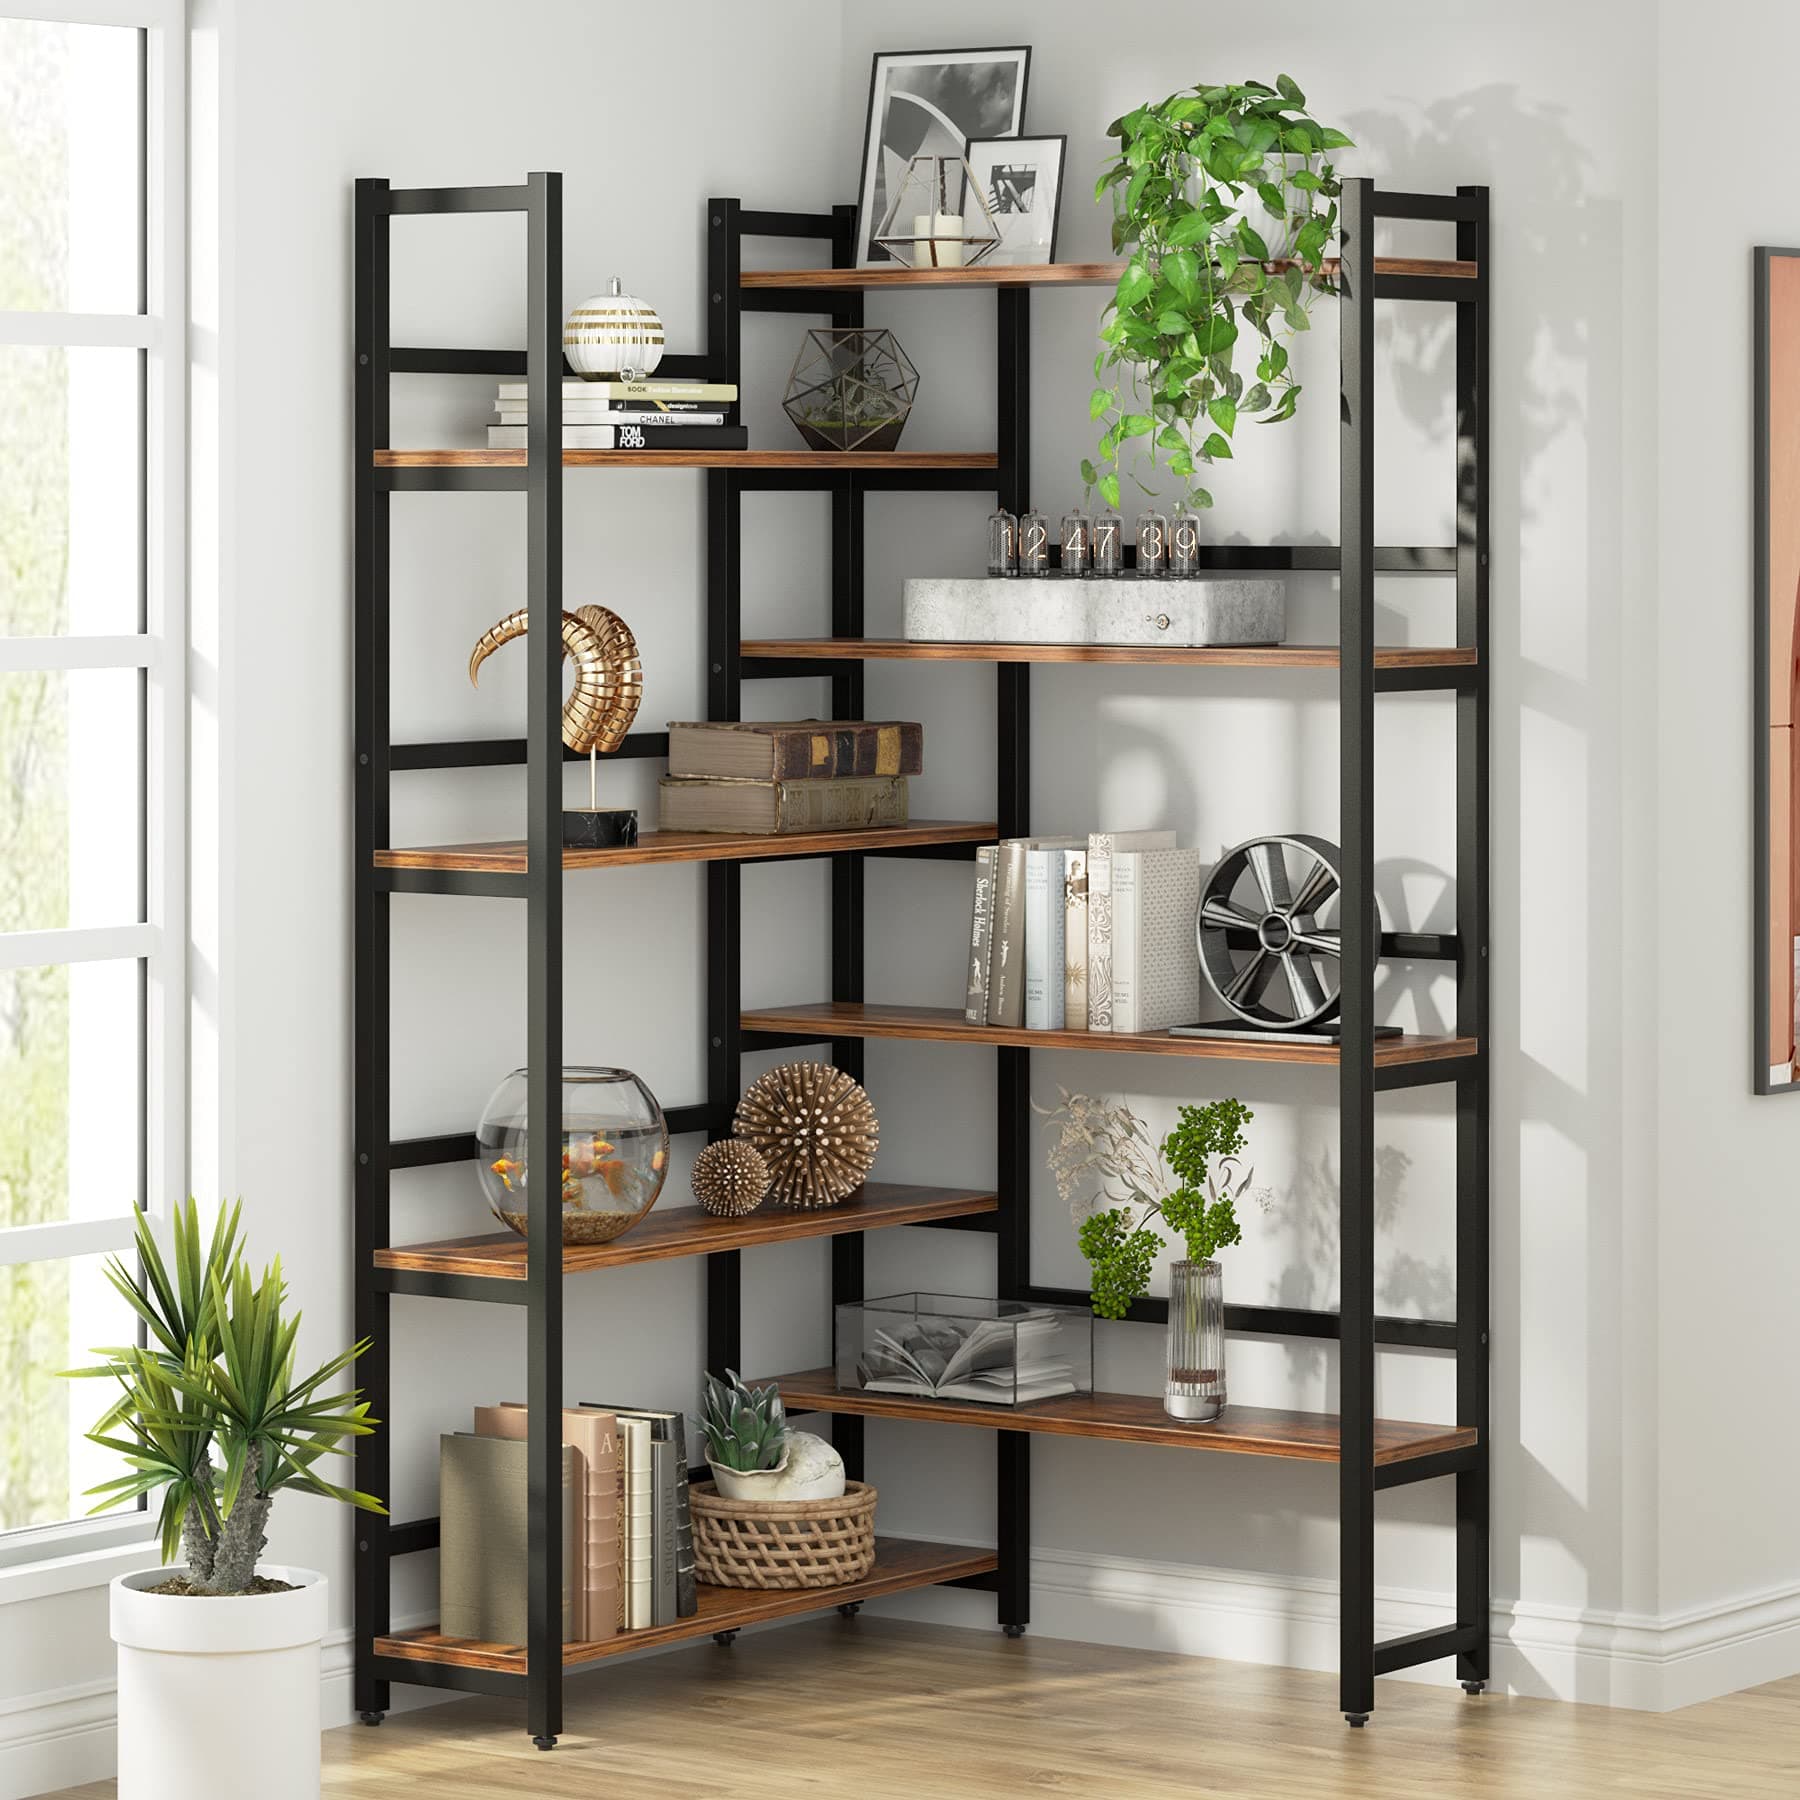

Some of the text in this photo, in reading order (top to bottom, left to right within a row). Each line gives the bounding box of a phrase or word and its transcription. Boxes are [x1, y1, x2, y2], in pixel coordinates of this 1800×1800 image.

[640, 415, 675, 424] CHANEL
[619, 426, 640, 437] TOM
[619, 437, 645, 448] FORD
[972, 877, 989, 947] Sherlock Holmes
[600, 1434, 613, 1454] A
